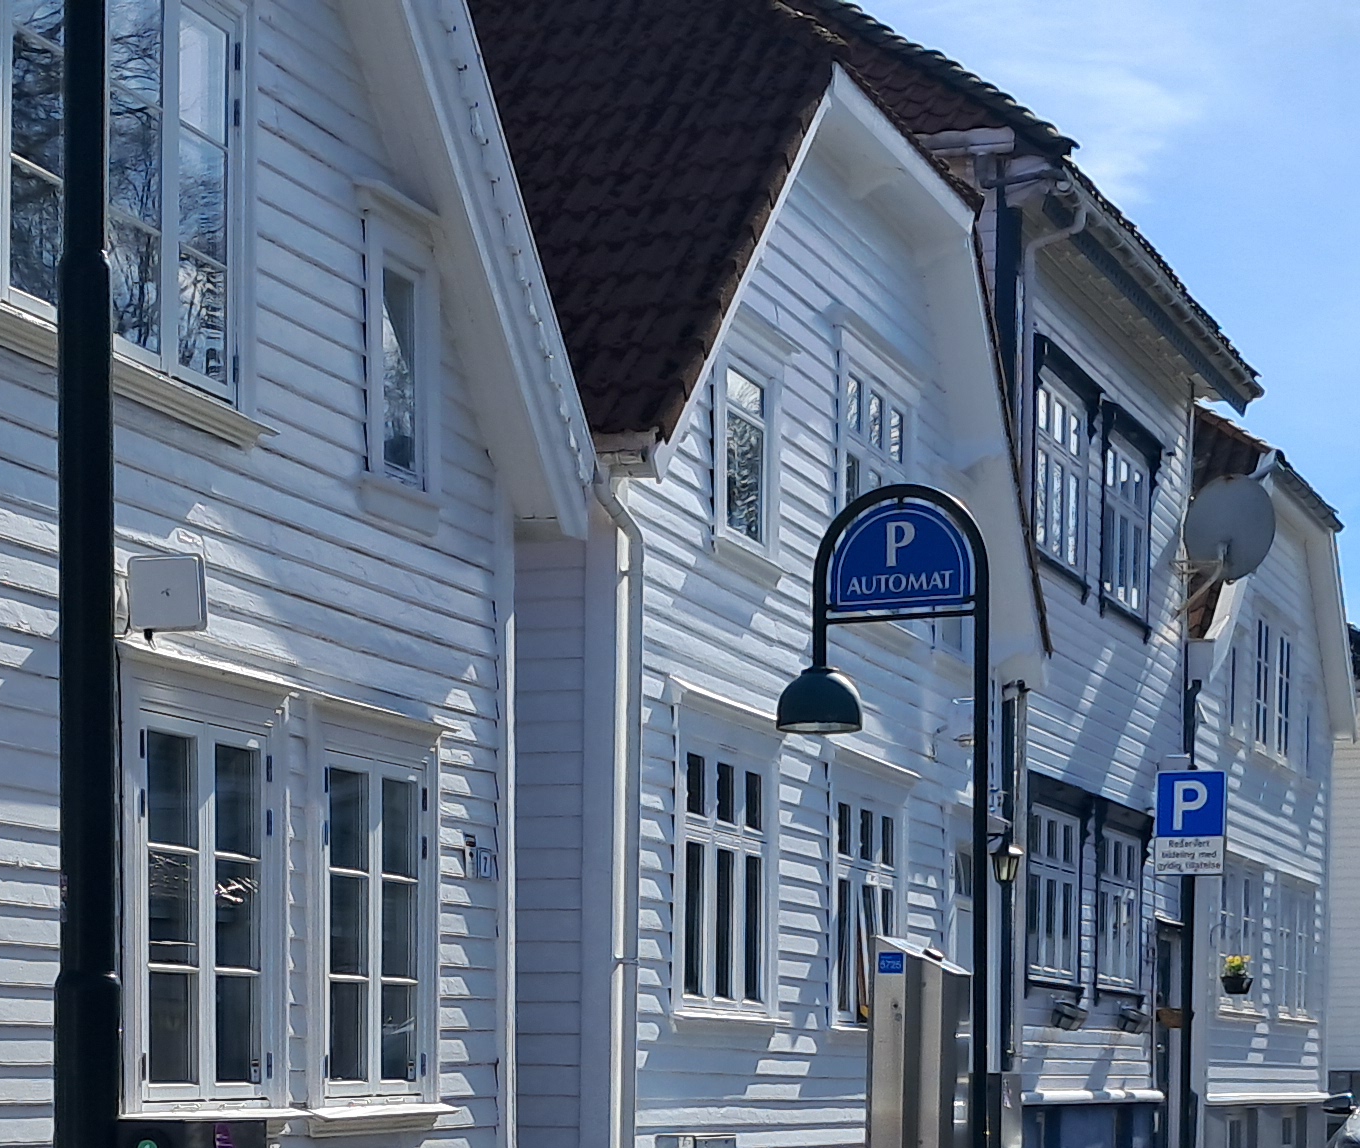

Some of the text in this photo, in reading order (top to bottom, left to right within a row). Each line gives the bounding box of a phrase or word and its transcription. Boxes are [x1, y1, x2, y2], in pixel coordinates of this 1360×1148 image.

[885, 520, 916, 568] P
[846, 569, 954, 596] AUTOMAT
[1172, 779, 1208, 831] P
